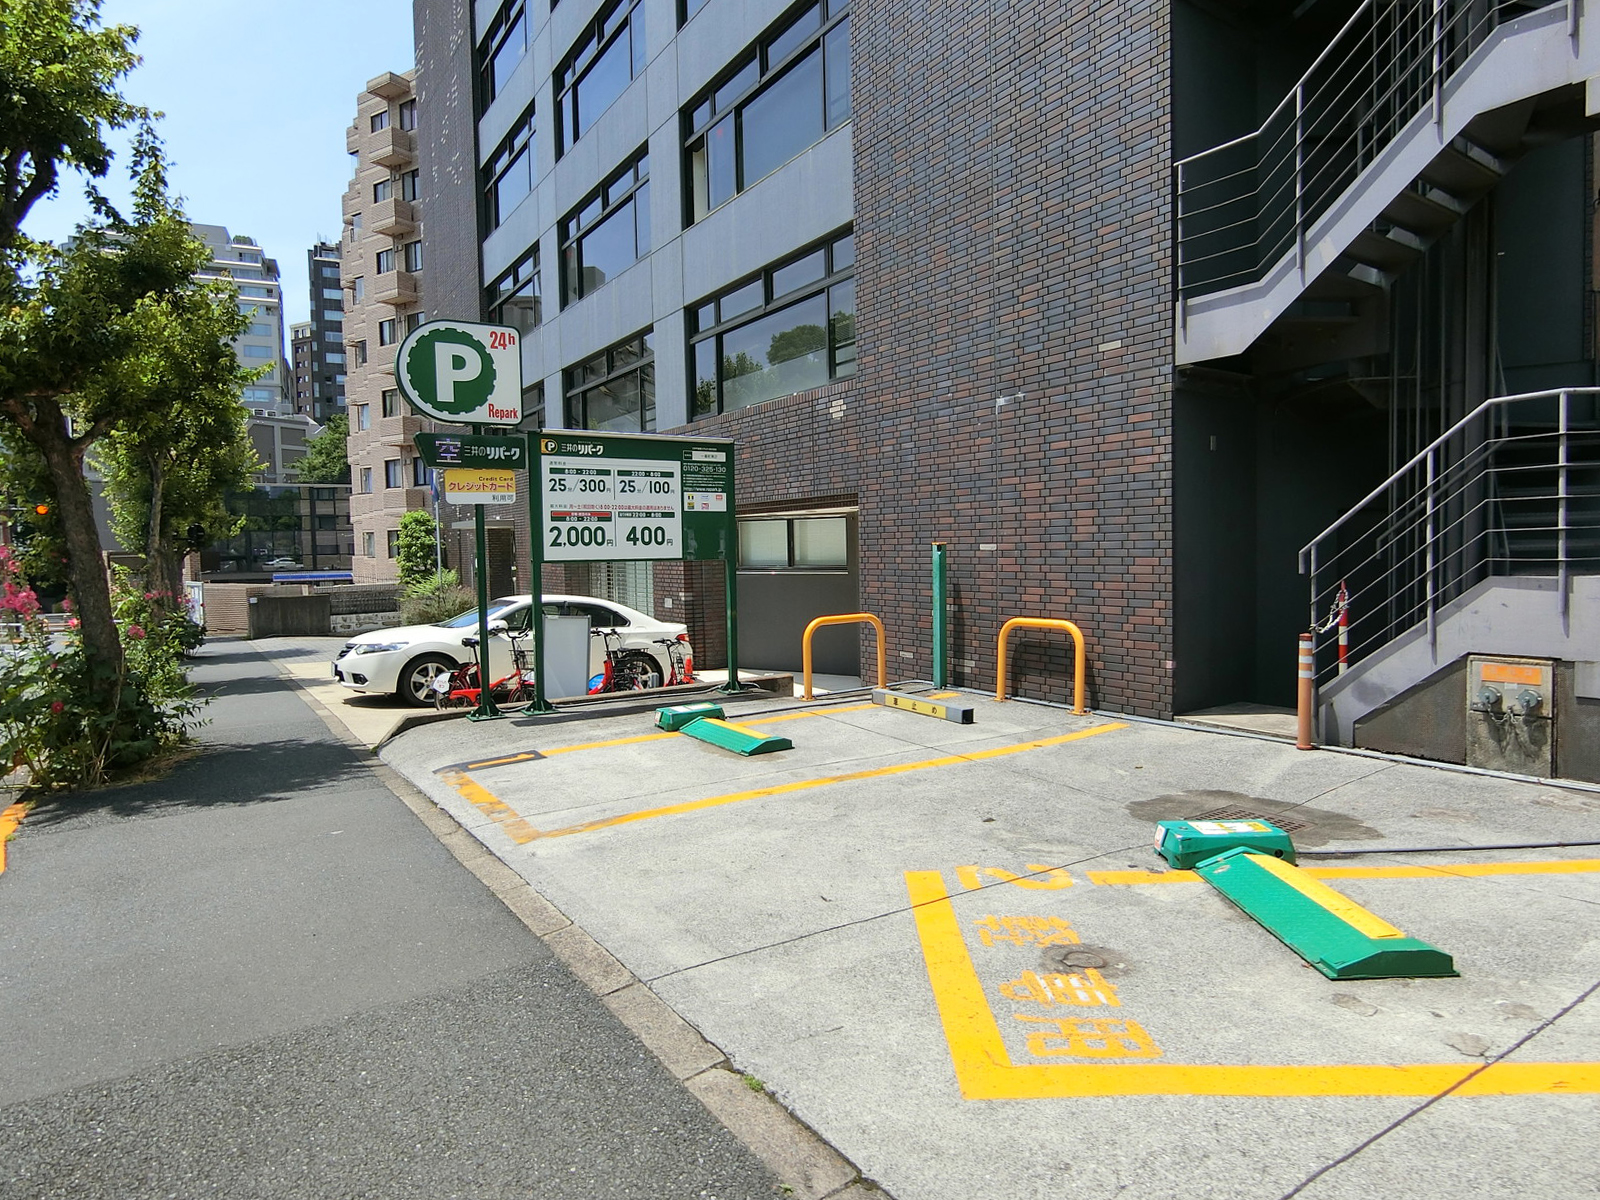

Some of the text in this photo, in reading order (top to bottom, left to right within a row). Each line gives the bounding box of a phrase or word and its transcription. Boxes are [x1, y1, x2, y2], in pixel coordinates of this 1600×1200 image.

[490, 331, 515, 350] 24h
[435, 342, 482, 402] P
[488, 404, 518, 420] Repark
[435, 438, 461, 463] 空
[464, 445, 520, 460] 三井のリパーク
[561, 443, 603, 455] 三井のリパーク
[448, 482, 513, 491] クレジットカード
